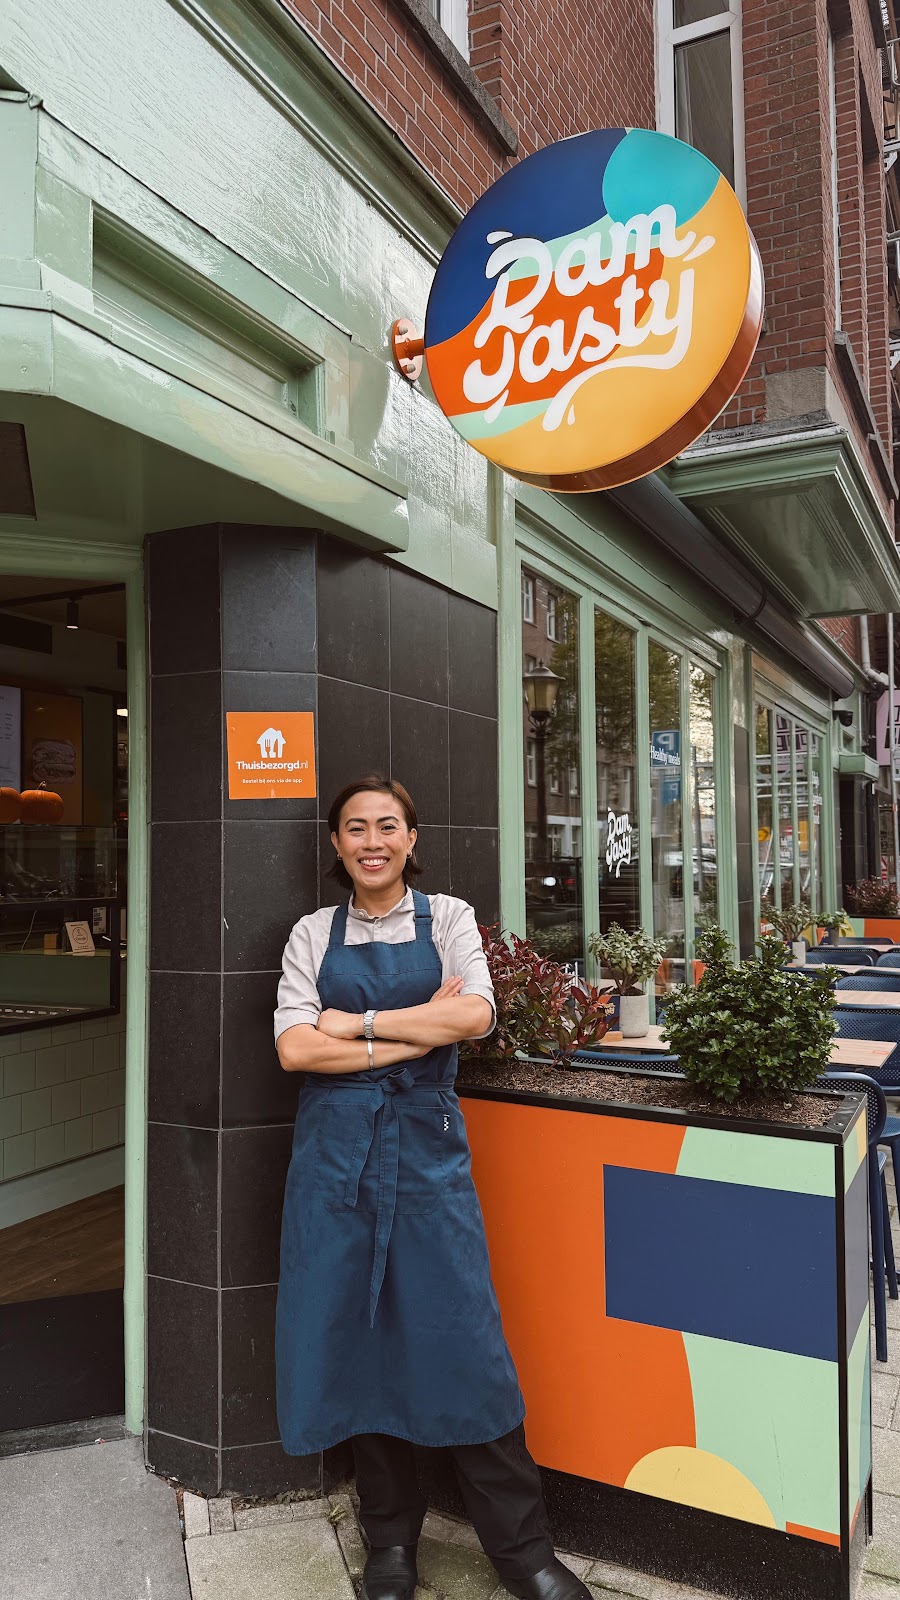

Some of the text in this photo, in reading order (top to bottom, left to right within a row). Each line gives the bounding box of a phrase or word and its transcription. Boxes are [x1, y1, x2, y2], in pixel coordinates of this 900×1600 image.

[474, 204, 702, 348] Dam
[463, 268, 695, 431] Tasty
[236, 760, 308, 771] Thuisbezorgd.nl
[650, 745, 680, 765] Healthy meals
[607, 806, 632, 846] Dam
